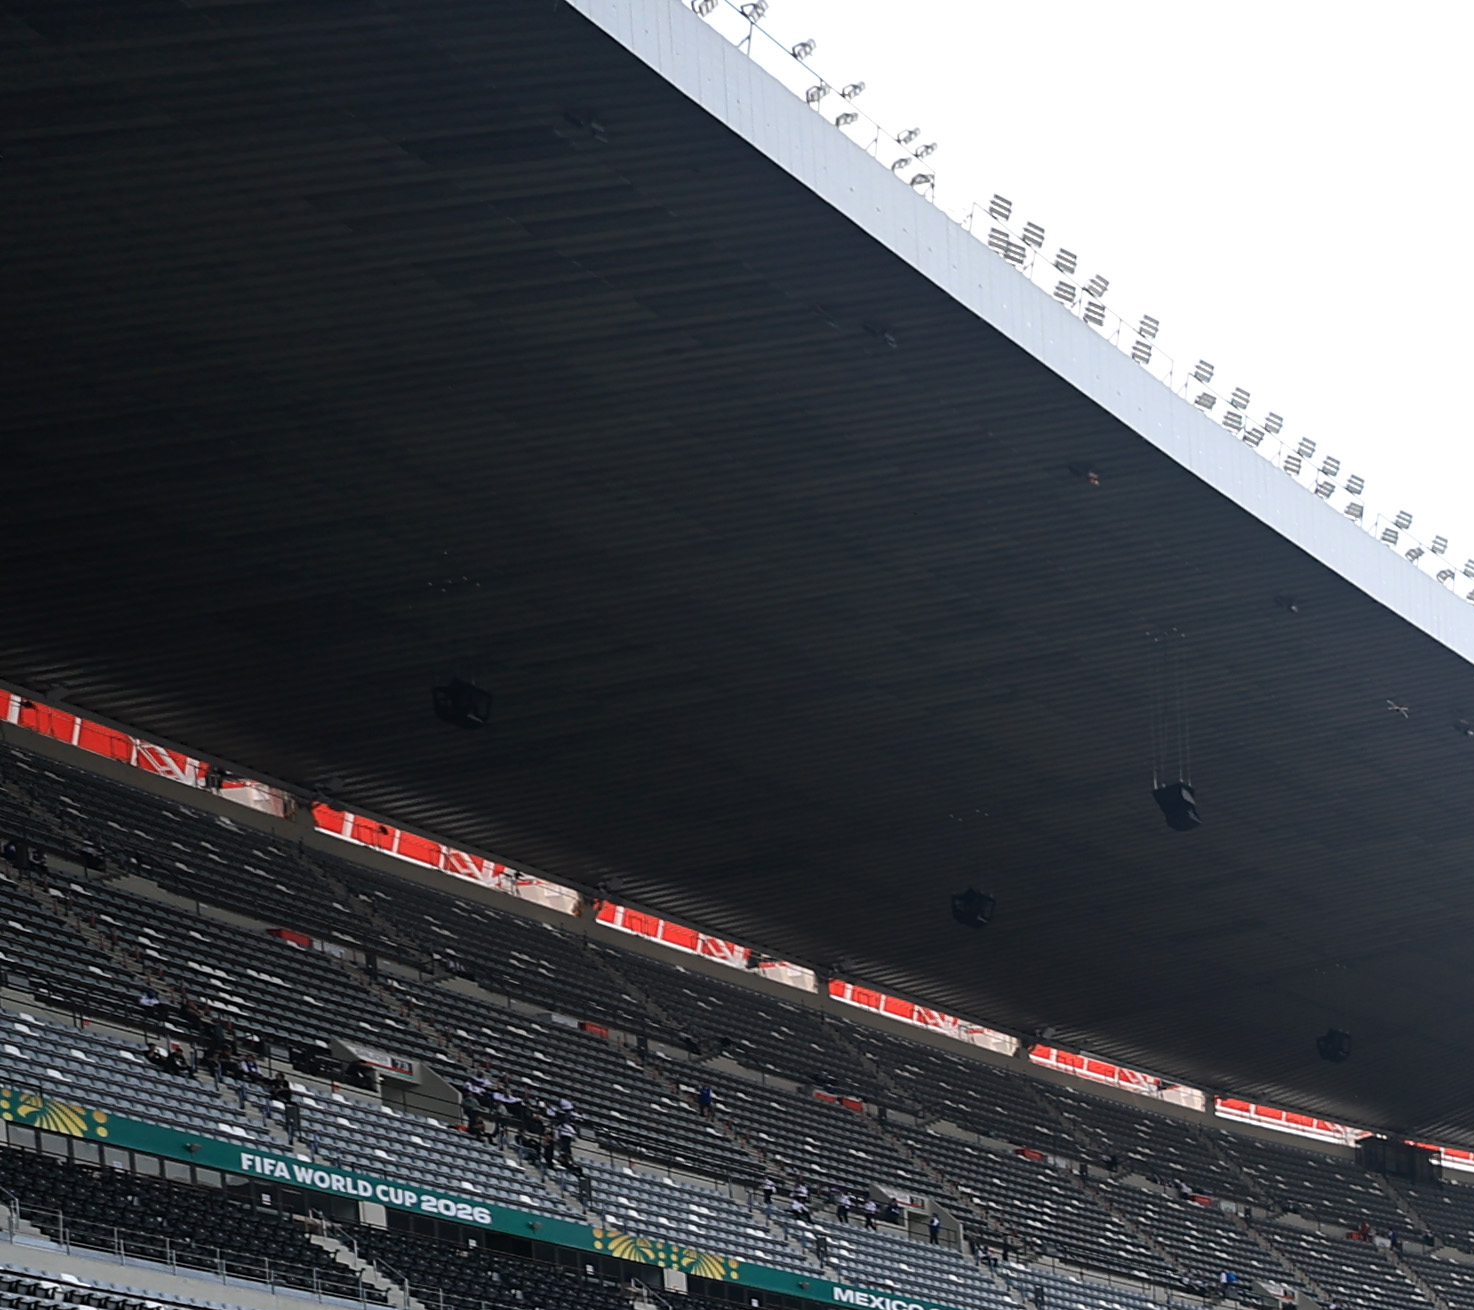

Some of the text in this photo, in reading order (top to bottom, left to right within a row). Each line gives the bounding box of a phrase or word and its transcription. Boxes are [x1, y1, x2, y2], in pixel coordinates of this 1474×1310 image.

[242, 1153, 494, 1225] FIFA WORLD CUP 2026
